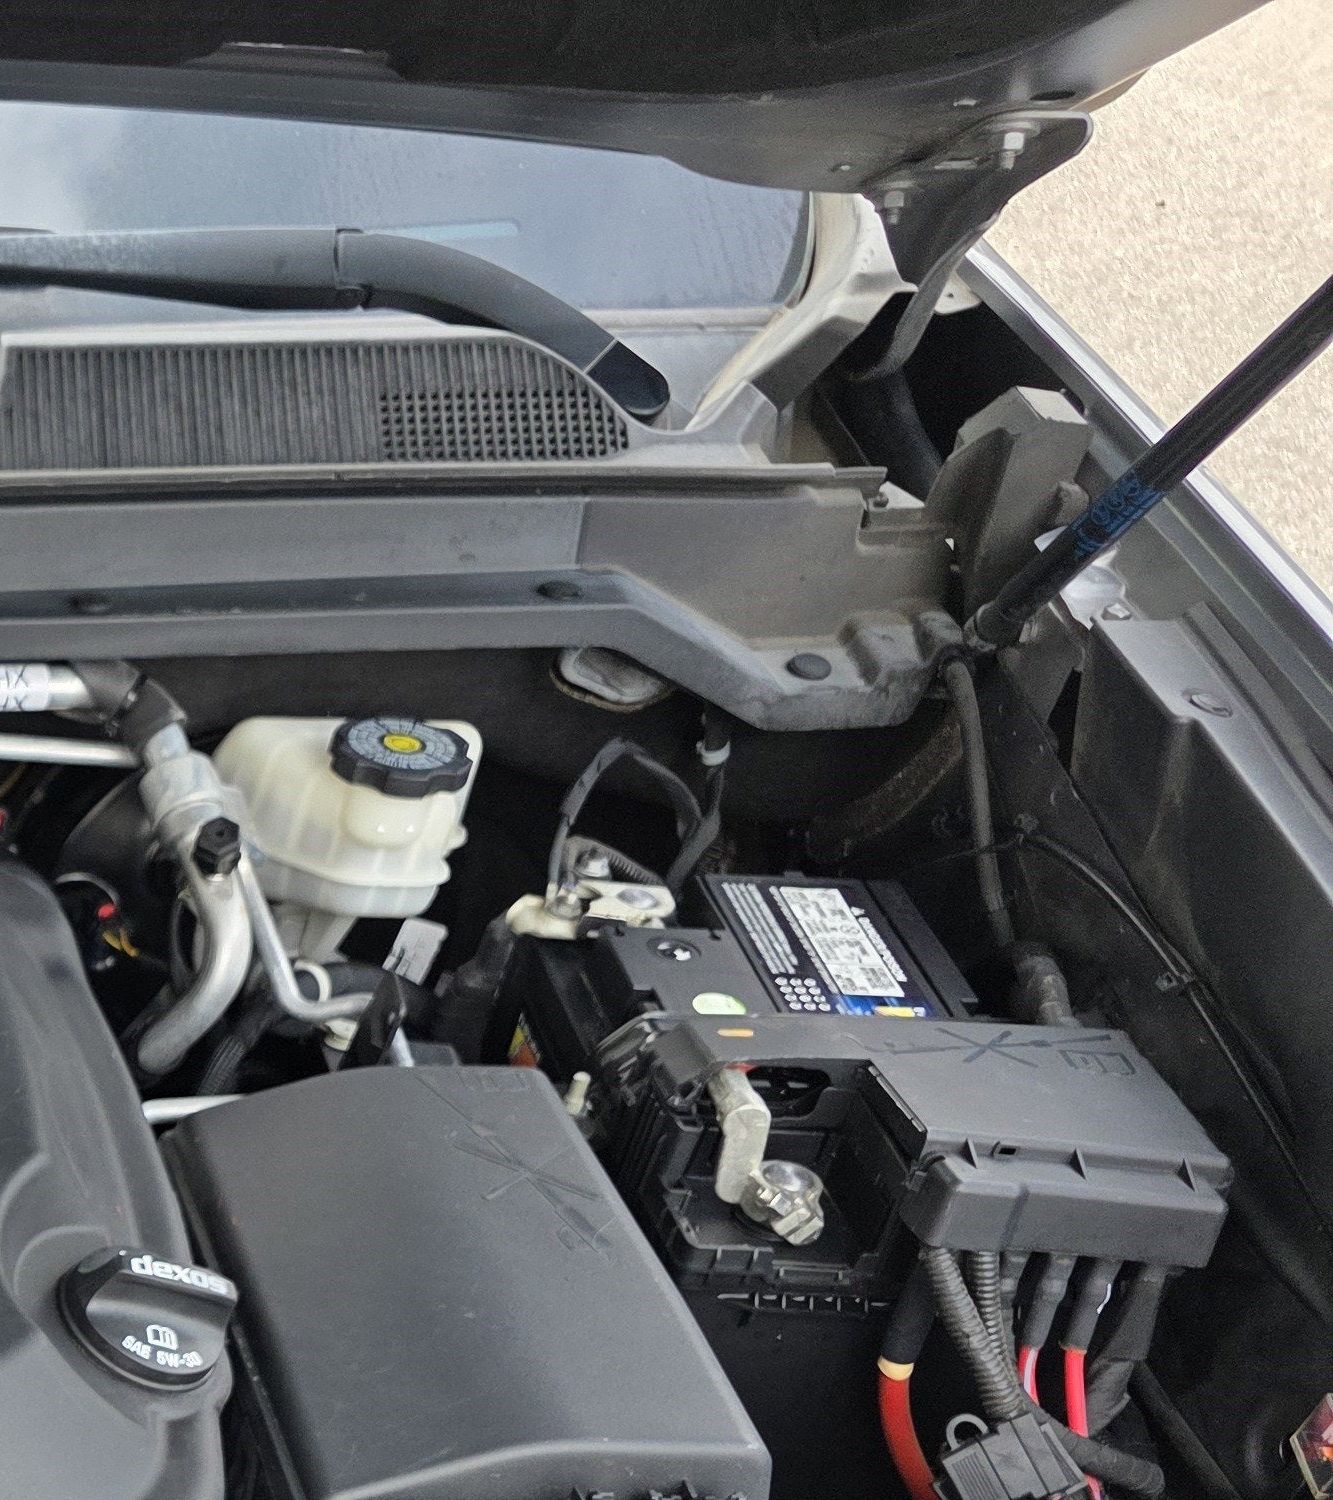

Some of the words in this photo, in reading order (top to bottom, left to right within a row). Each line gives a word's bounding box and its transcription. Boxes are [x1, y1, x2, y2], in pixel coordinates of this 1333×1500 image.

[130, 1254, 229, 1296] dexos
[121, 1335, 153, 1360] SAE
[156, 1351, 204, 1368] 5W-30
